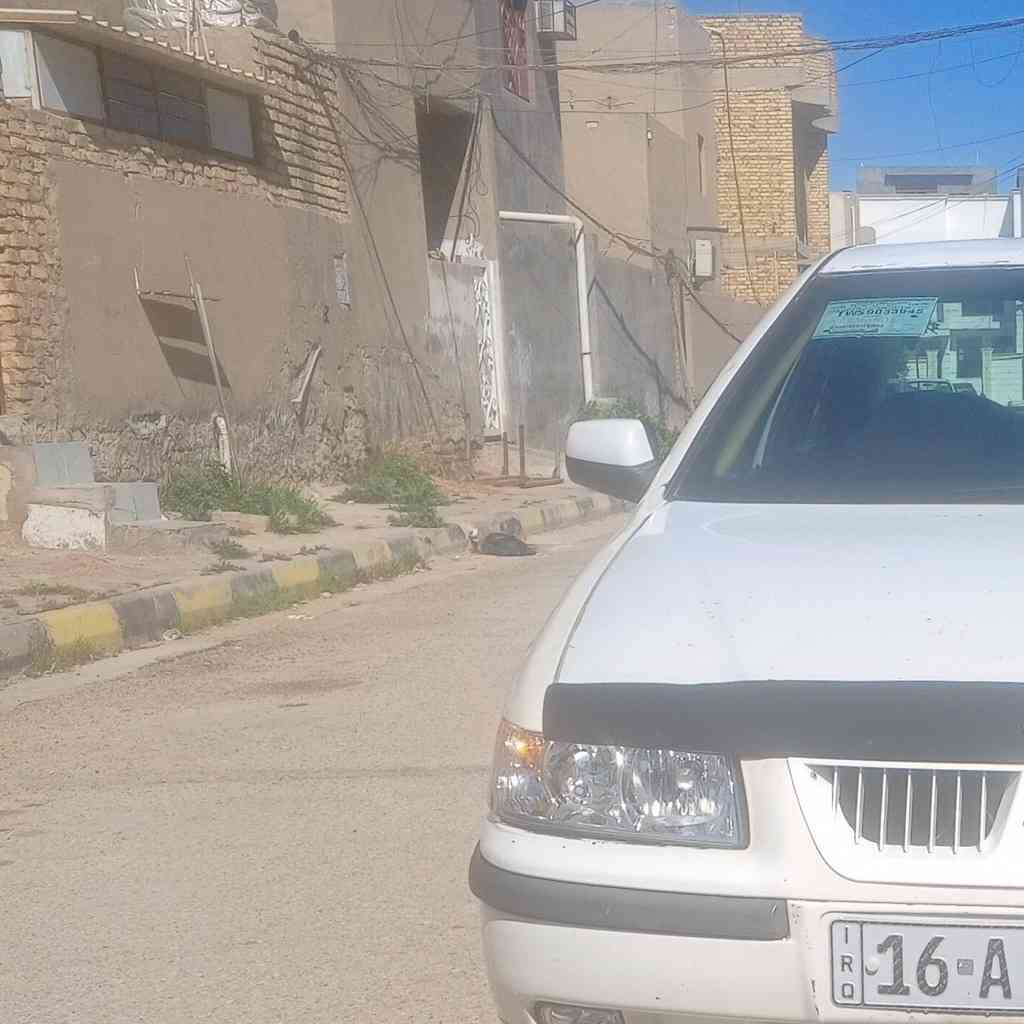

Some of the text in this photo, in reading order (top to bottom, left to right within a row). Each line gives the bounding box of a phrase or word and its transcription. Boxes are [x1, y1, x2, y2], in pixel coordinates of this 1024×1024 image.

[840, 927, 855, 1000] IRQ
[876, 934, 947, 997] 16
[979, 938, 1012, 1000] A
